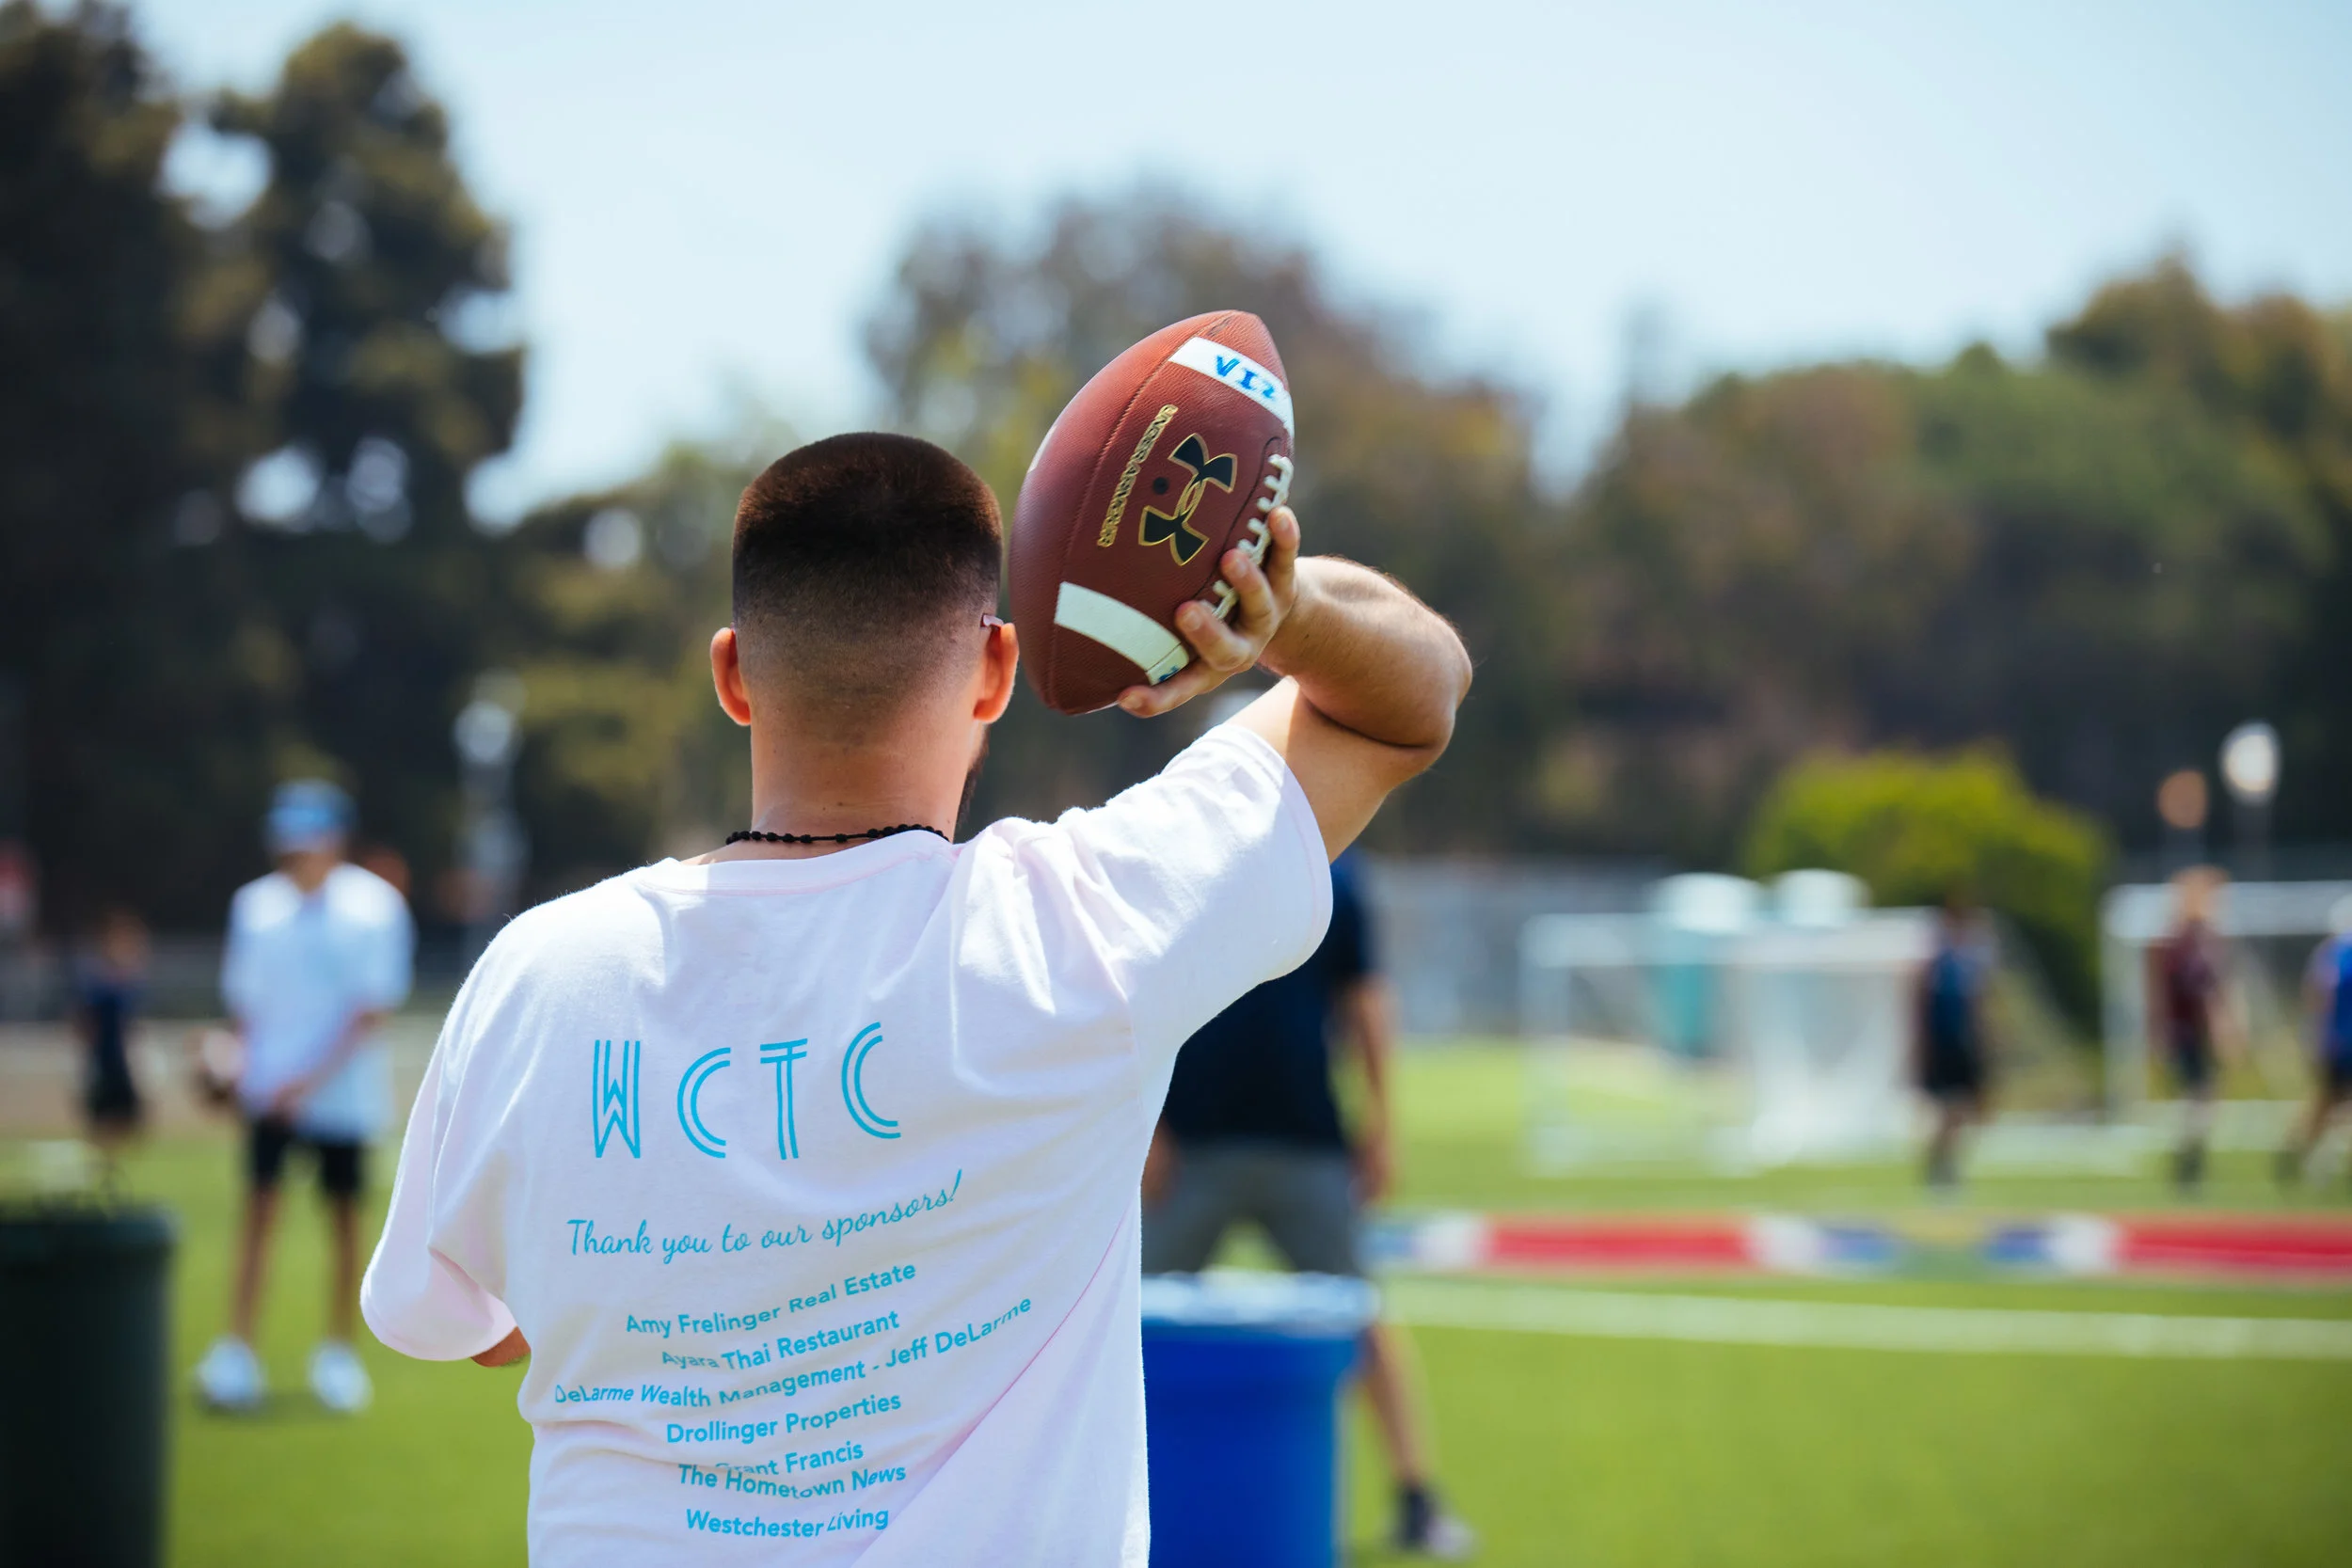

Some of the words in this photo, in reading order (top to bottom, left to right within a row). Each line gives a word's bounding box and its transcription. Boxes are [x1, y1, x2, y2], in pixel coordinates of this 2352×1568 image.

[591, 1021, 902, 1161] WCTC
[566, 1218, 653, 1257] Thank
[661, 1234, 713, 1266] you
[722, 1223, 752, 1254] to
[760, 1225, 813, 1250] our
[821, 1168, 962, 1248] sponsors!
[626, 1314, 672, 1339] Amy
[677, 1306, 781, 1334] Frelinger
[788, 1283, 837, 1313] Real
[844, 1264, 916, 1296] Estate
[554, 1384, 635, 1404] DeLarme
[640, 1384, 712, 1408] Wealth
[718, 1360, 866, 1405] Management
[884, 1336, 929, 1369] Jeff
[933, 1298, 1032, 1354] DeLarme
[661, 1351, 720, 1370] Ayara
[721, 1341, 771, 1370] Thai
[777, 1310, 900, 1360] Restaurant
[666, 1419, 779, 1446] Drollinger
[785, 1393, 902, 1434] Properties
[678, 1464, 718, 1488] The
[725, 1468, 846, 1499] Hometown
[850, 1465, 907, 1492] News
[715, 1459, 780, 1476] rant
[785, 1440, 865, 1474] Francis
[686, 1508, 825, 1538] Westchester
[826, 1508, 889, 1532] Living
